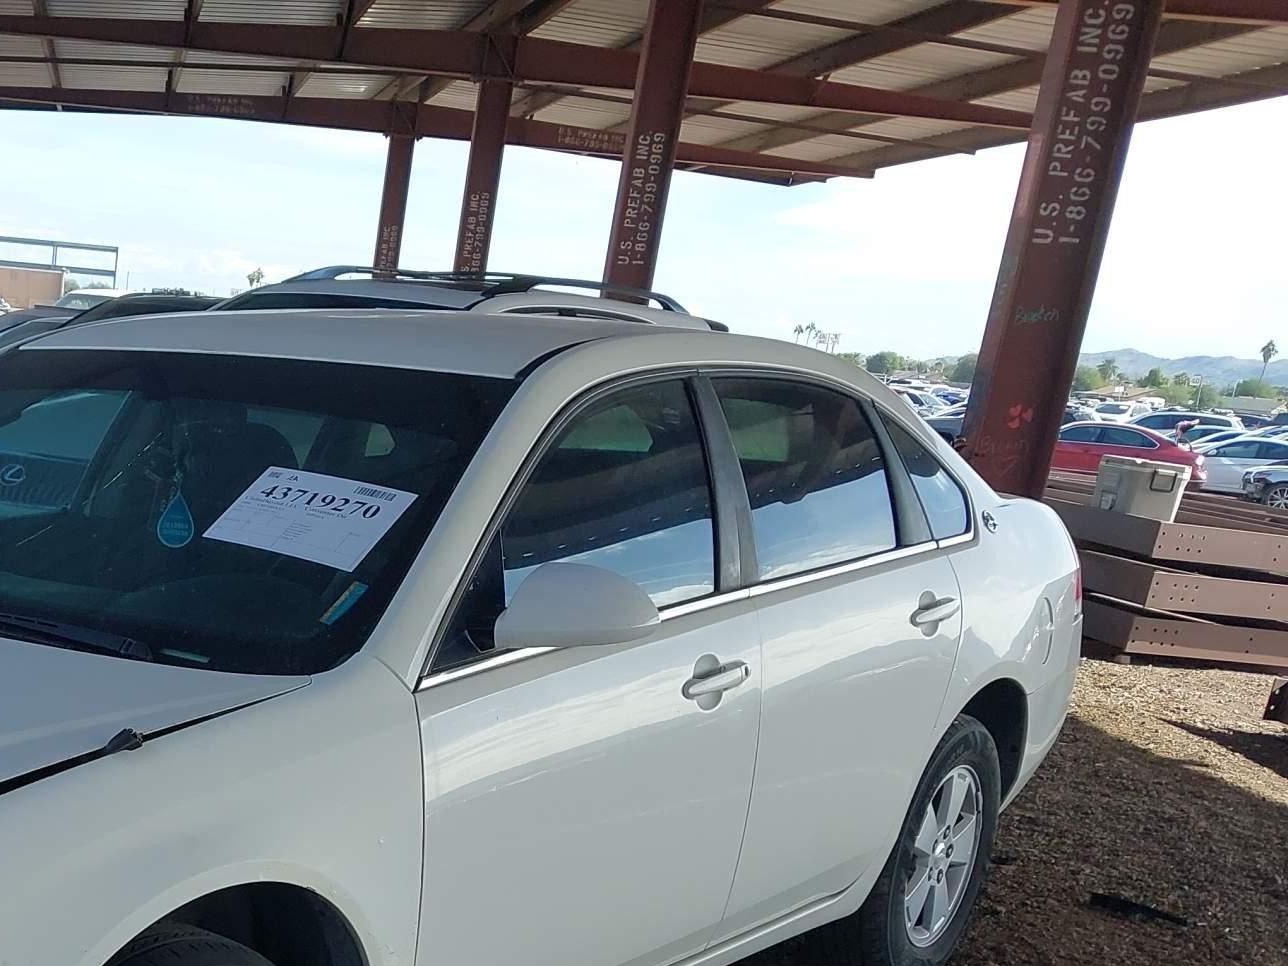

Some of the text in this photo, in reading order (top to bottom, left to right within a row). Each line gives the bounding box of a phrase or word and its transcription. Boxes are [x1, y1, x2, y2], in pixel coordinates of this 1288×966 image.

[1032, 0, 1109, 244] U.S. PREFAB INC.
[1058, 3, 1135, 244] 1-866-799-0969
[463, 216, 477, 258] PREFAB
[617, 130, 653, 265] U.S. PREFAB INC.
[632, 132, 665, 265] 1-866-799-0969
[260, 484, 381, 519] 43719270
